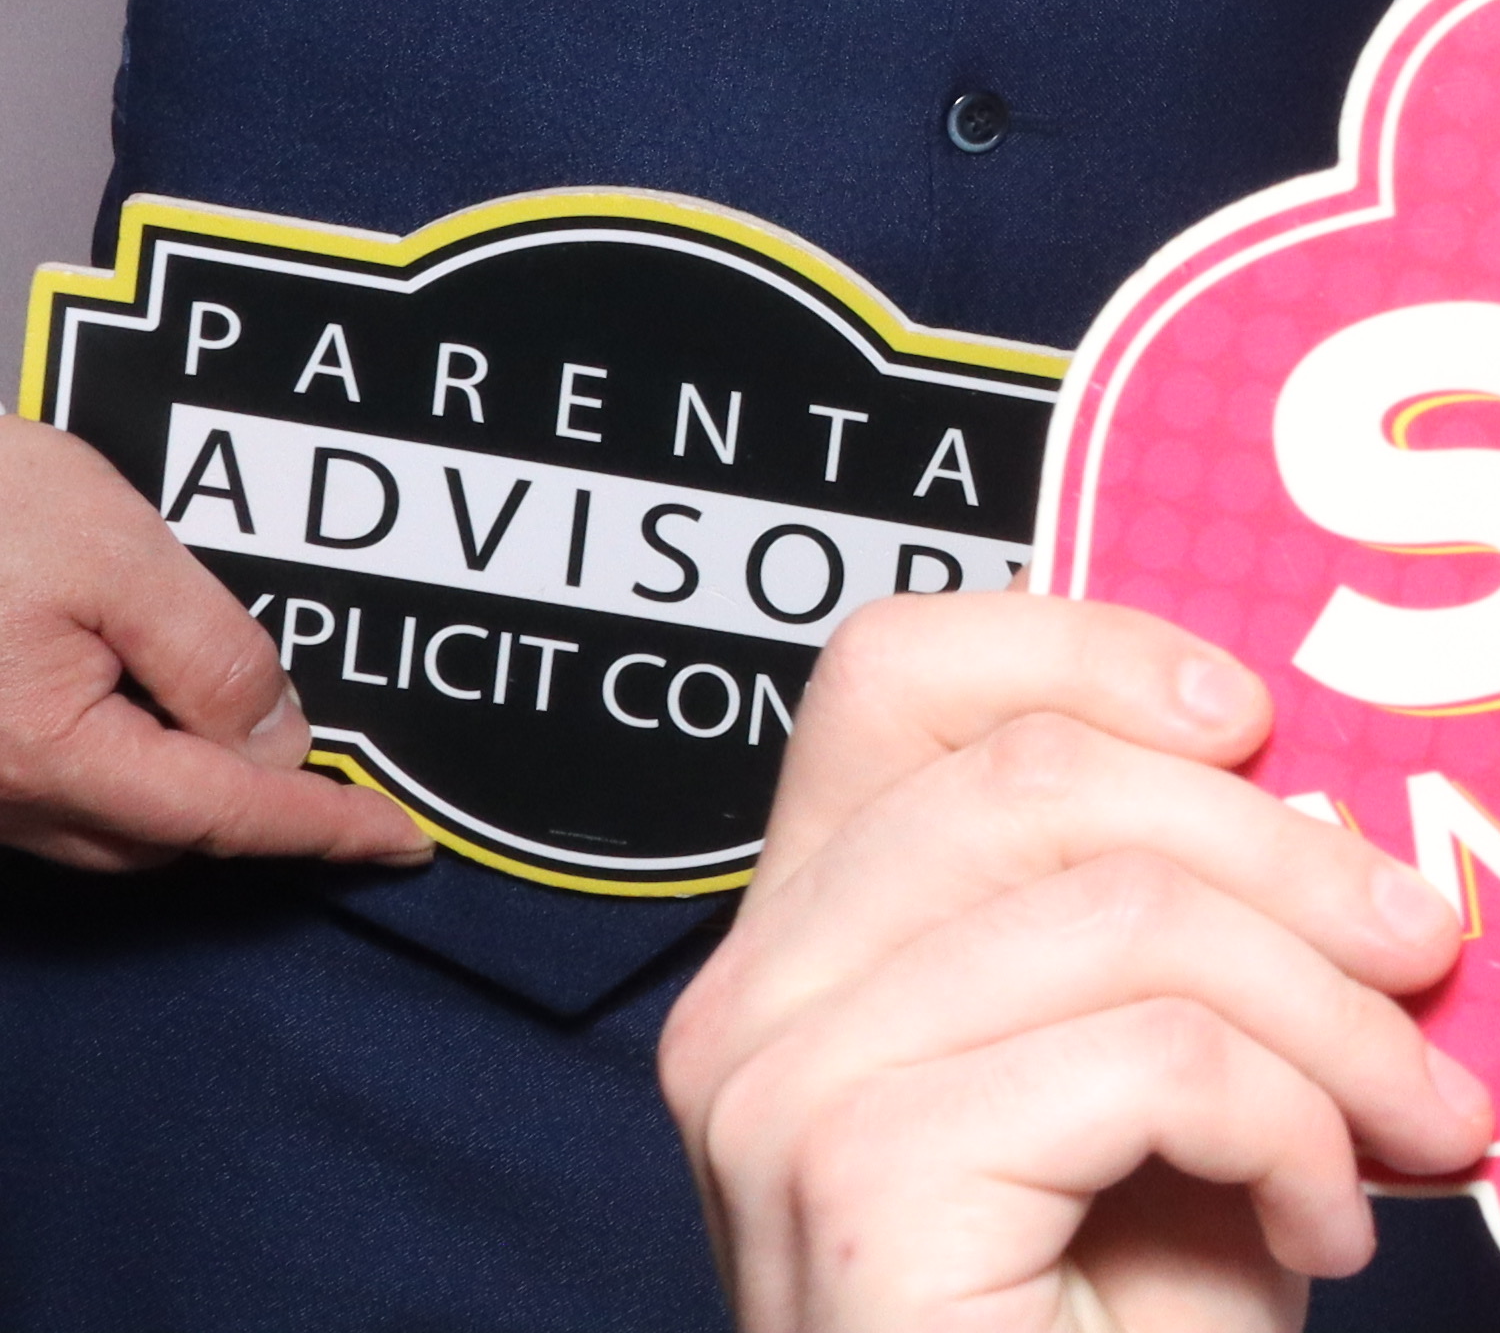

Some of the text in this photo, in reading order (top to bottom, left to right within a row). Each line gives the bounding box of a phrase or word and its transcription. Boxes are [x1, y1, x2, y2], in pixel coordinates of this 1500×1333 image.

[183, 299, 981, 508] PARENTA
[165, 426, 1024, 625] ADVISOR
[248, 592, 580, 713] PLICIT
